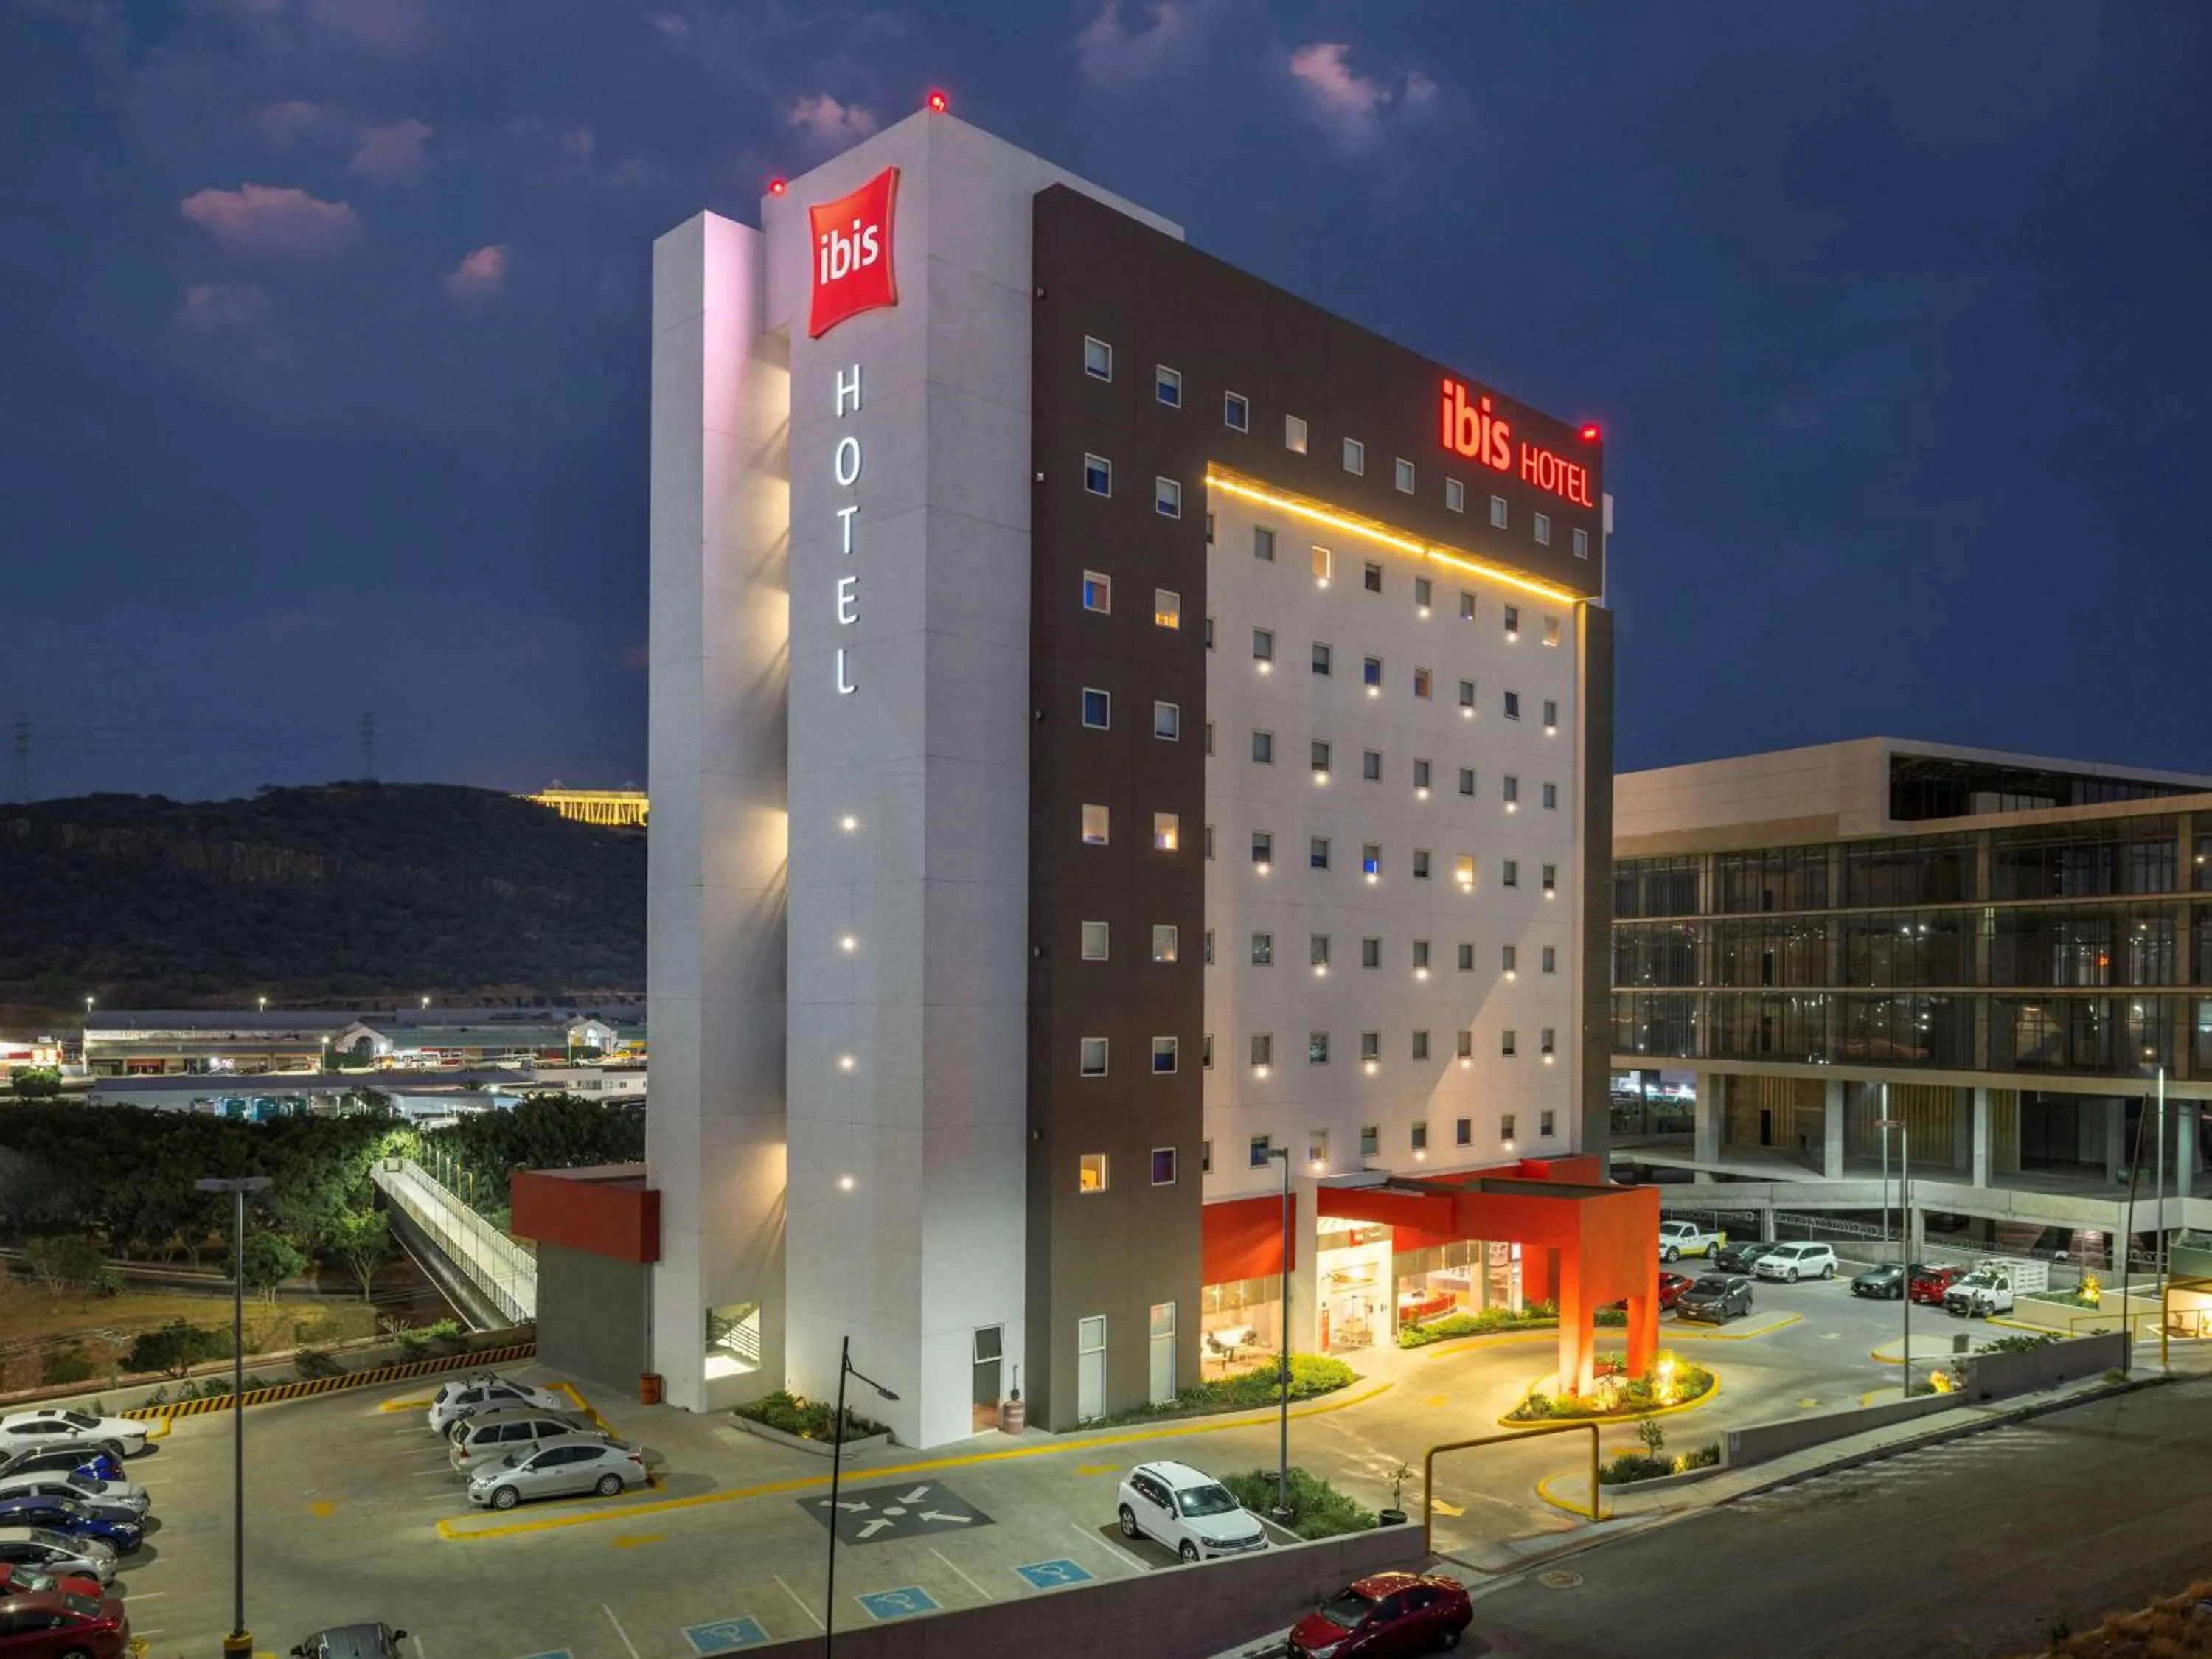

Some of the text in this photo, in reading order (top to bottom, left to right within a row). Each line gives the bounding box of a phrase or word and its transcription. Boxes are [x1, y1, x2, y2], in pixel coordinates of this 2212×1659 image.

[821, 219, 878, 284] ibis
[1442, 380, 1593, 507] ibis HOTEL
[835, 364, 860, 694] HOTEL
